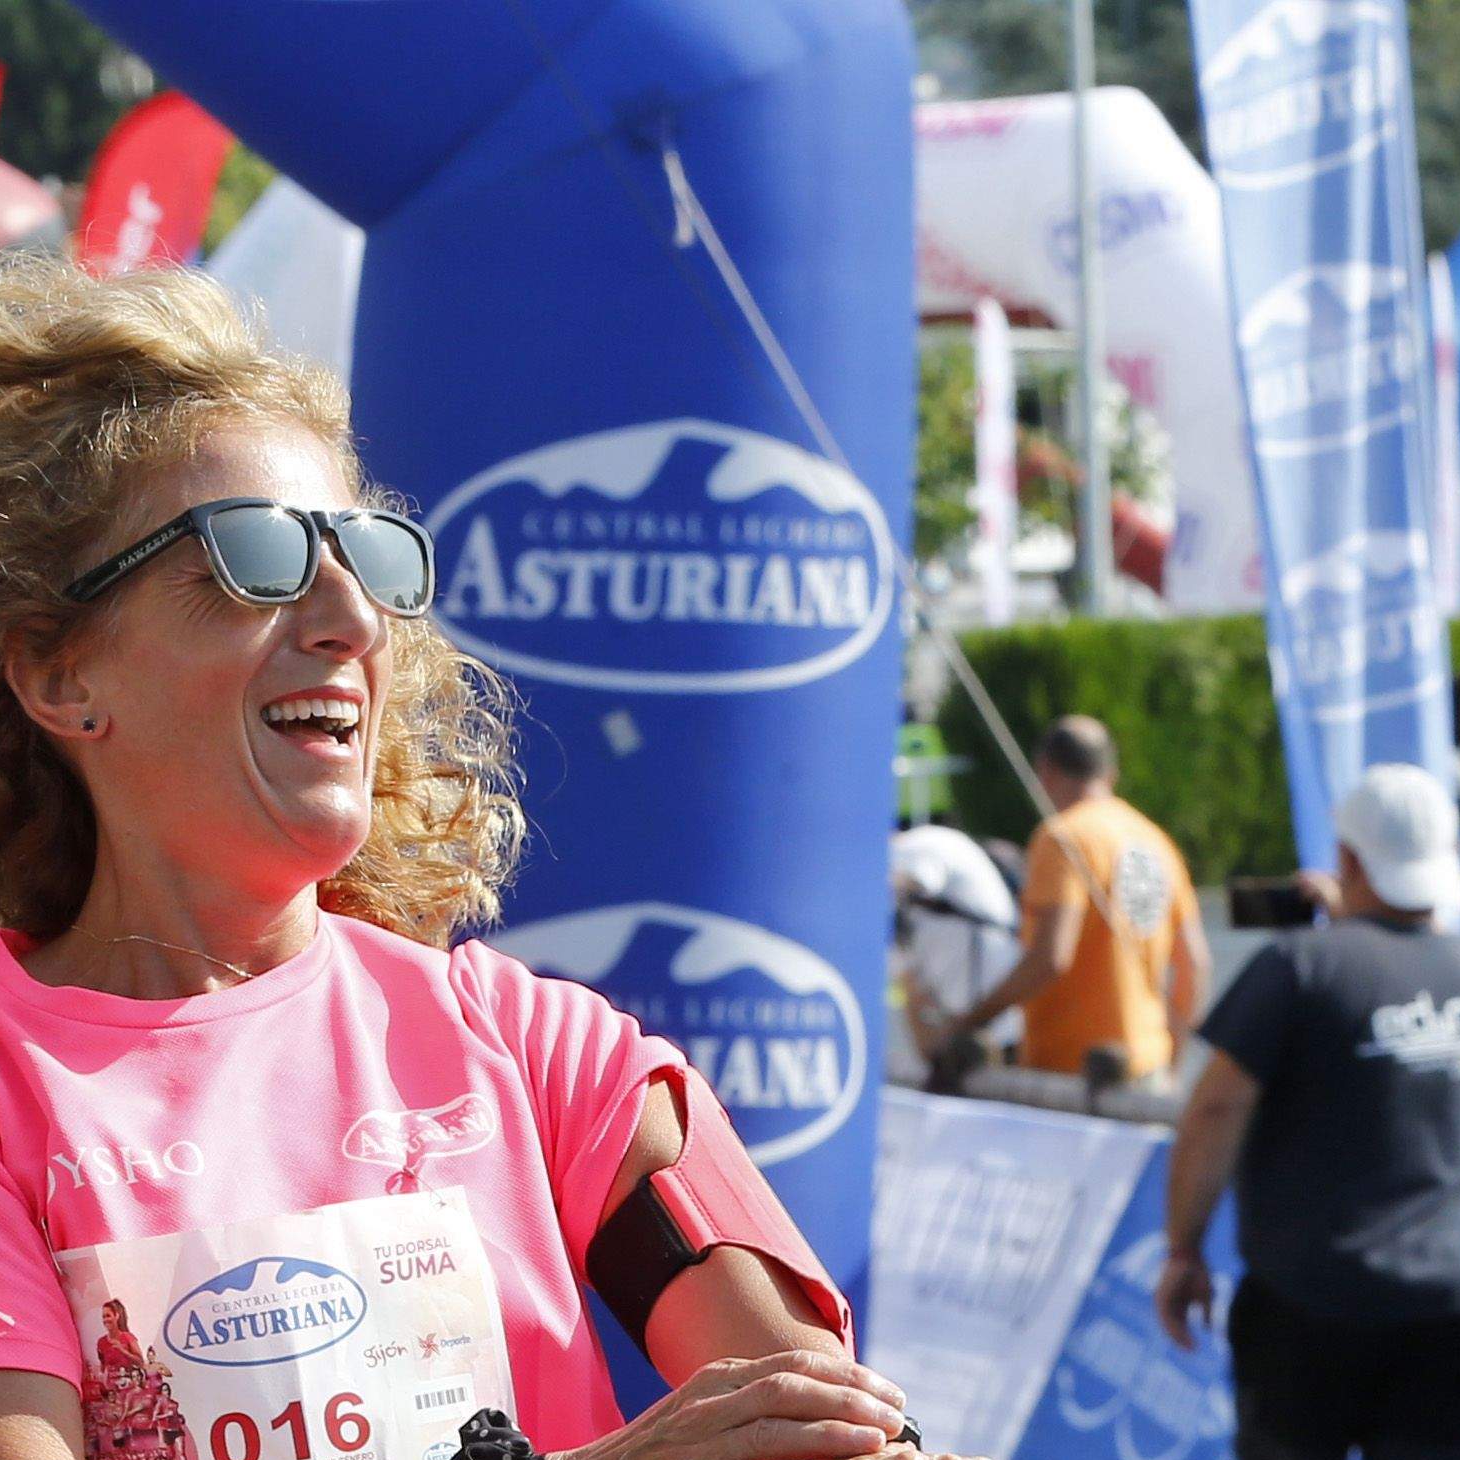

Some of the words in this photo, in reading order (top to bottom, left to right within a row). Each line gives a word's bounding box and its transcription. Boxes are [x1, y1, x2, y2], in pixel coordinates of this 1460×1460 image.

[445, 513, 872, 629] ASTURIANA
[374, 1246, 392, 1260] TU
[396, 1236, 452, 1256] DORSAL
[379, 1251, 457, 1285] SUMA
[211, 1293, 279, 1314] CENTRAL
[284, 1281, 345, 1300] LECHERA
[182, 1296, 356, 1350] ASTURIANA
